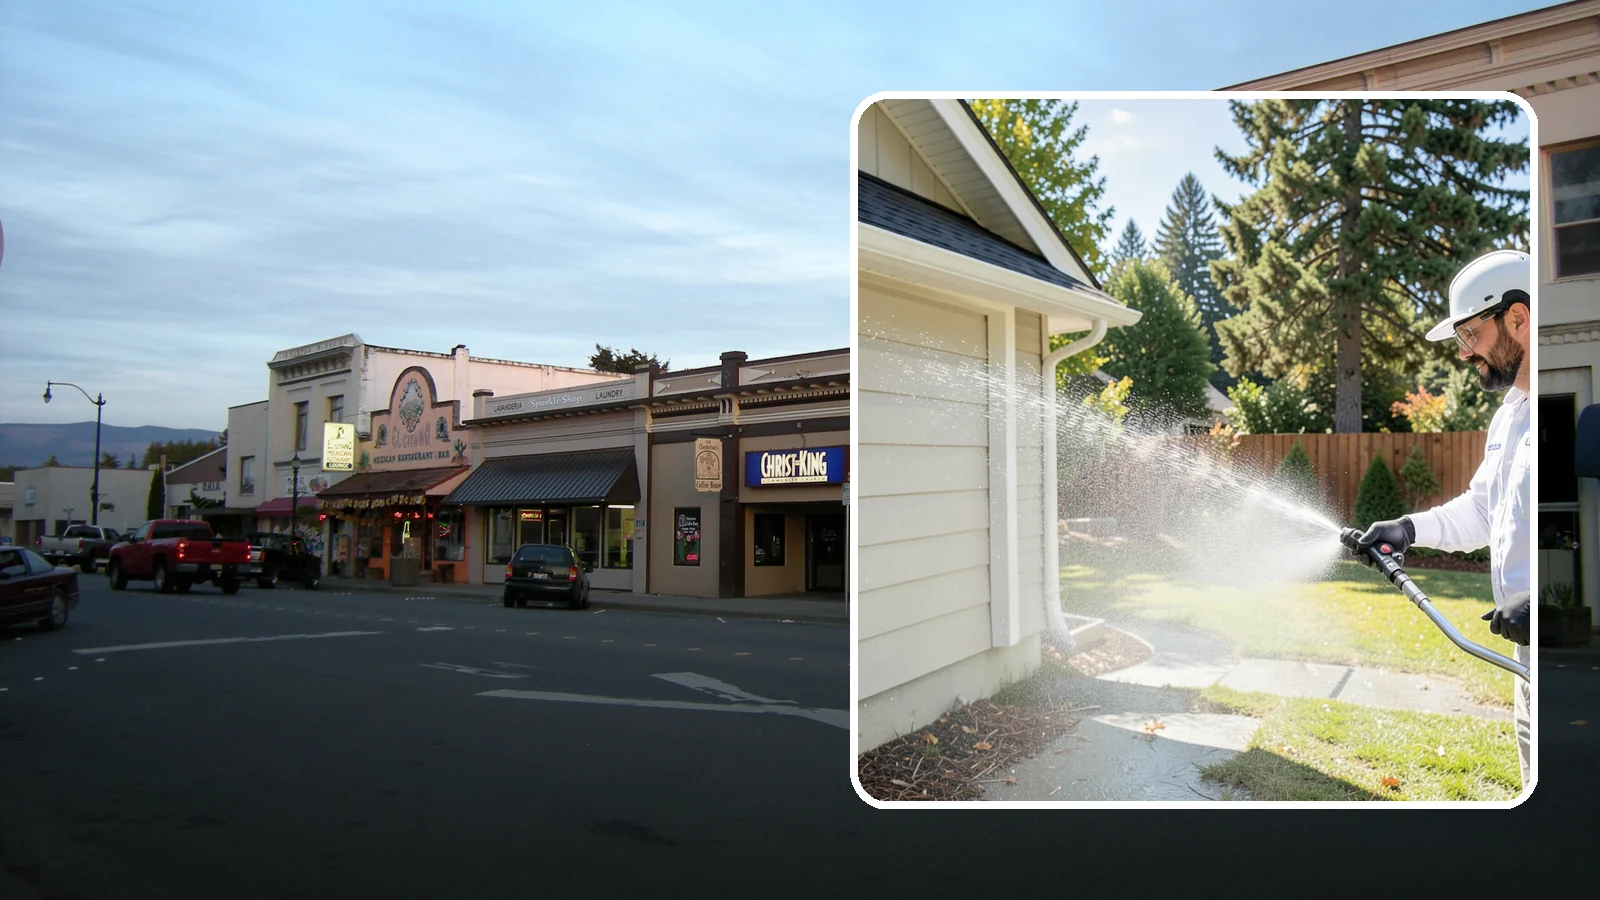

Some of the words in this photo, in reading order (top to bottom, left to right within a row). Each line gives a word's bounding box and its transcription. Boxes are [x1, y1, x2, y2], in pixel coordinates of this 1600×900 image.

[595, 389, 623, 399] LAUNDRY
[494, 402, 523, 412] LAVANDERIA
[531, 397, 561, 409] Sparkle
[561, 394, 582, 405] Shop
[392, 425, 401, 449] EL
[373, 455, 396, 464] MEXICAN
[397, 451, 433, 462] RESTAURANT
[438, 450, 450, 459] BAR
[761, 452, 797, 478] CHRIST
[799, 450, 827, 477] KING
